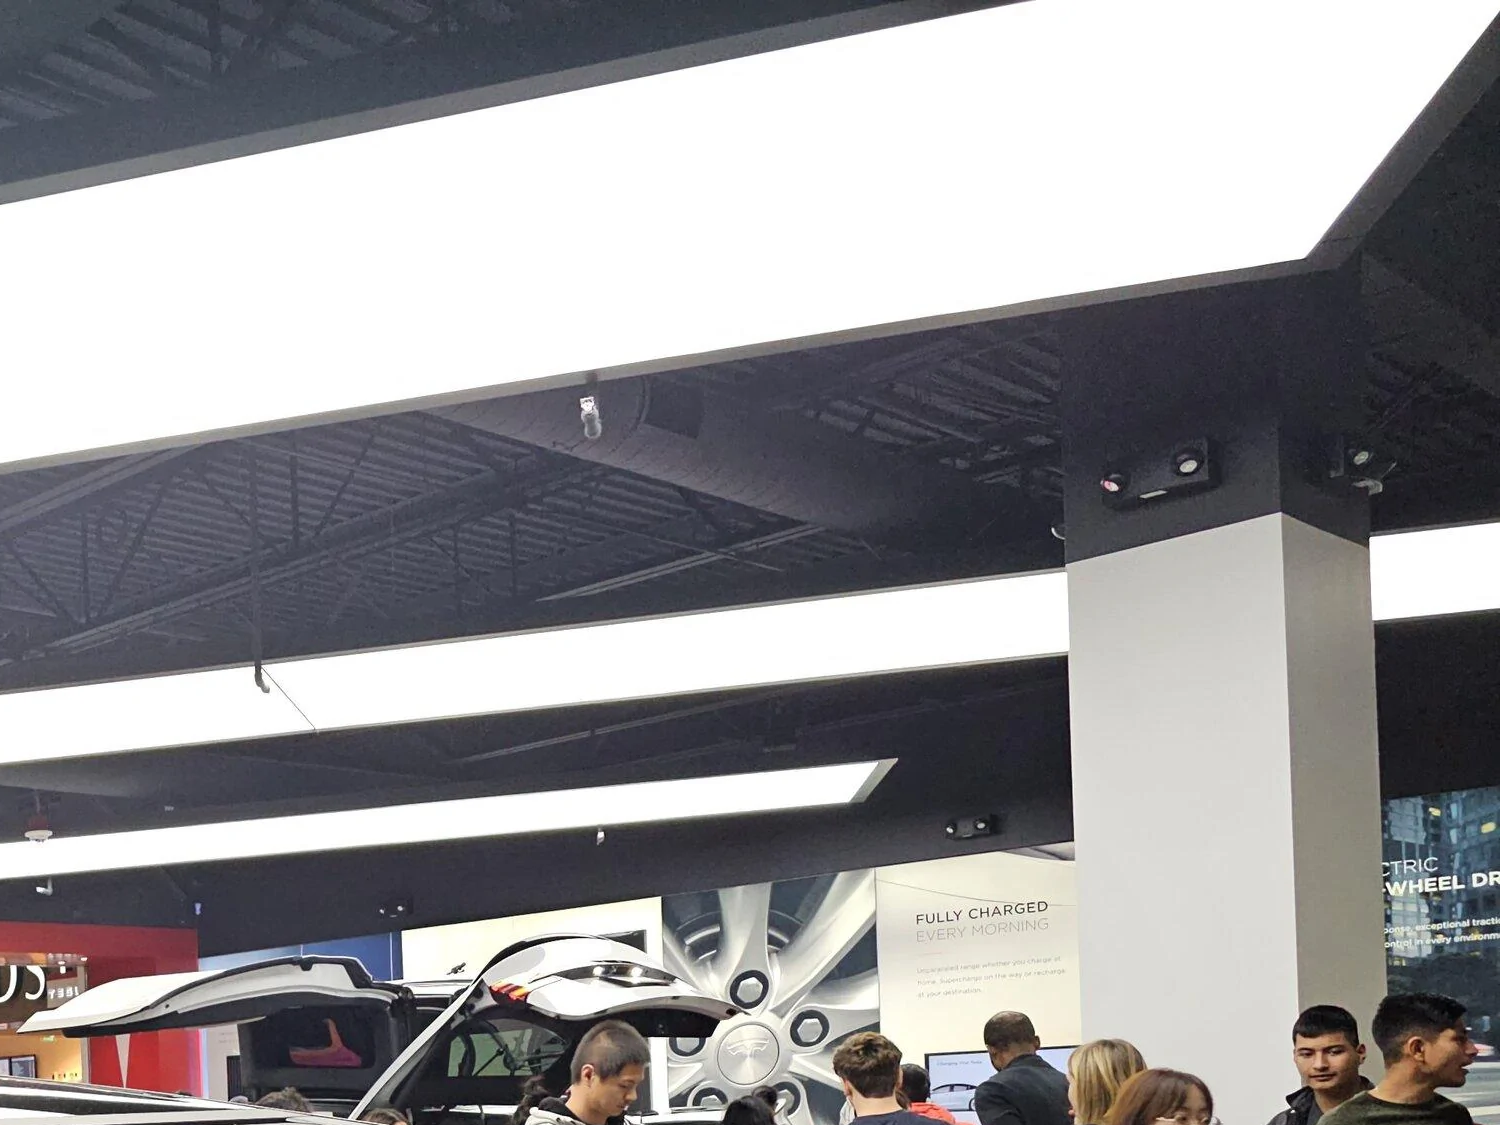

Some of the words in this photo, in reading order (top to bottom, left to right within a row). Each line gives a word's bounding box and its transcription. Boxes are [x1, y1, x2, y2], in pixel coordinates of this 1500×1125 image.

[916, 909, 962, 925] FULLY
[968, 901, 1048, 920] CHARGED
[916, 926, 966, 942] EVERY
[971, 917, 1049, 936] MORNING
[1415, 919, 1470, 931] exceptional
[1425, 935, 1452, 945] every
[1453, 932, 1500, 942] environm
[982, 960, 1011, 969] whether
[1012, 959, 1026, 967] you
[1027, 956, 1053, 965] charge
